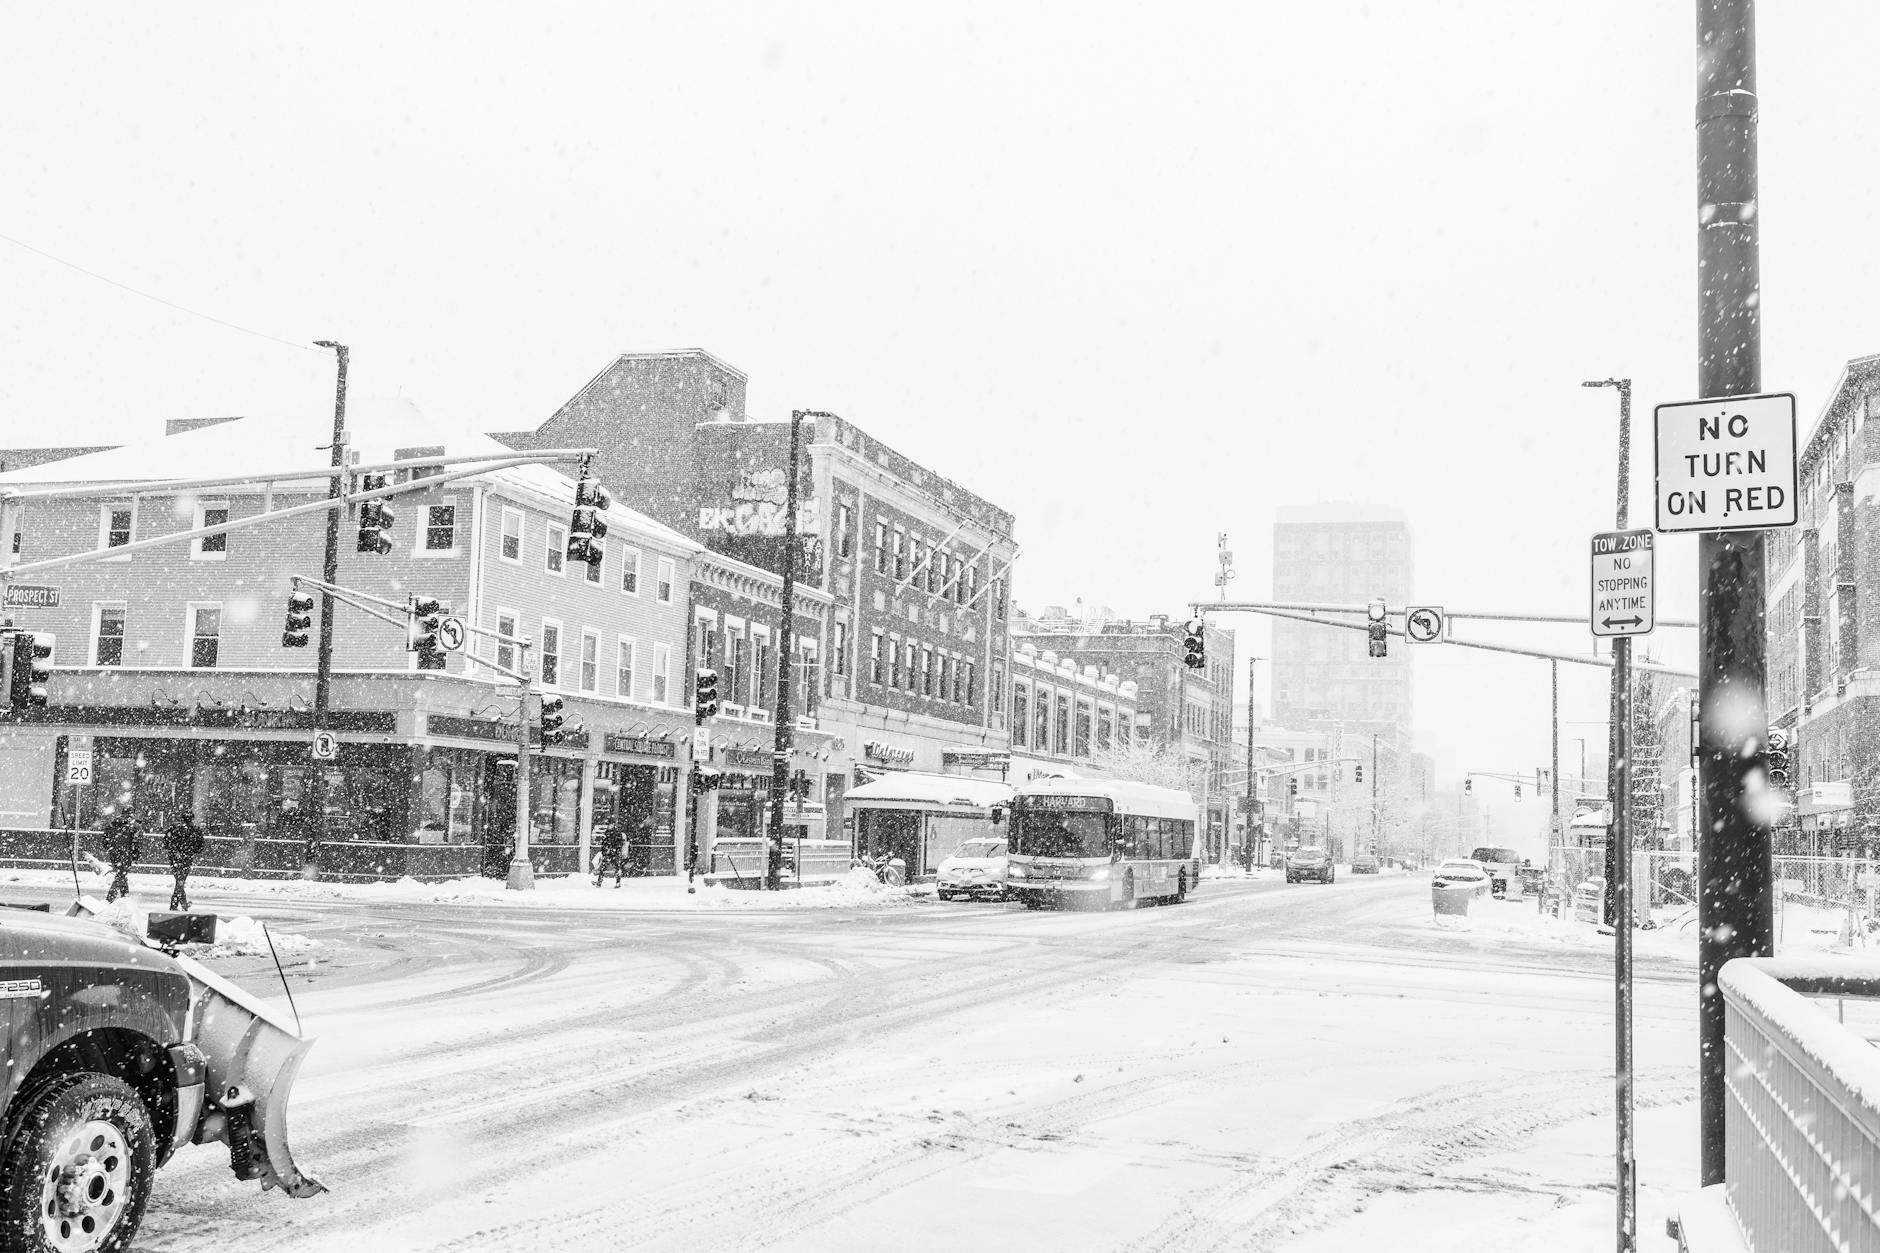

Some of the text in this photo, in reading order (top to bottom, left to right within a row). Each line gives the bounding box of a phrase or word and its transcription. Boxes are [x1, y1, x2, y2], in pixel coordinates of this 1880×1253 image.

[1700, 414, 1749, 441] NO
[1685, 449, 1766, 478] TURN
[1667, 485, 1785, 516] ON RED
[1593, 533, 1652, 553] TOW ZONE
[1613, 557, 1631, 570] NO
[1598, 576, 1648, 591] STOPPING
[8, 590, 59, 603] PROSPECT ST
[1599, 596, 1646, 611] ANYTIME
[70, 767, 89, 780] 20
[1043, 796, 1086, 808] HARVARD
